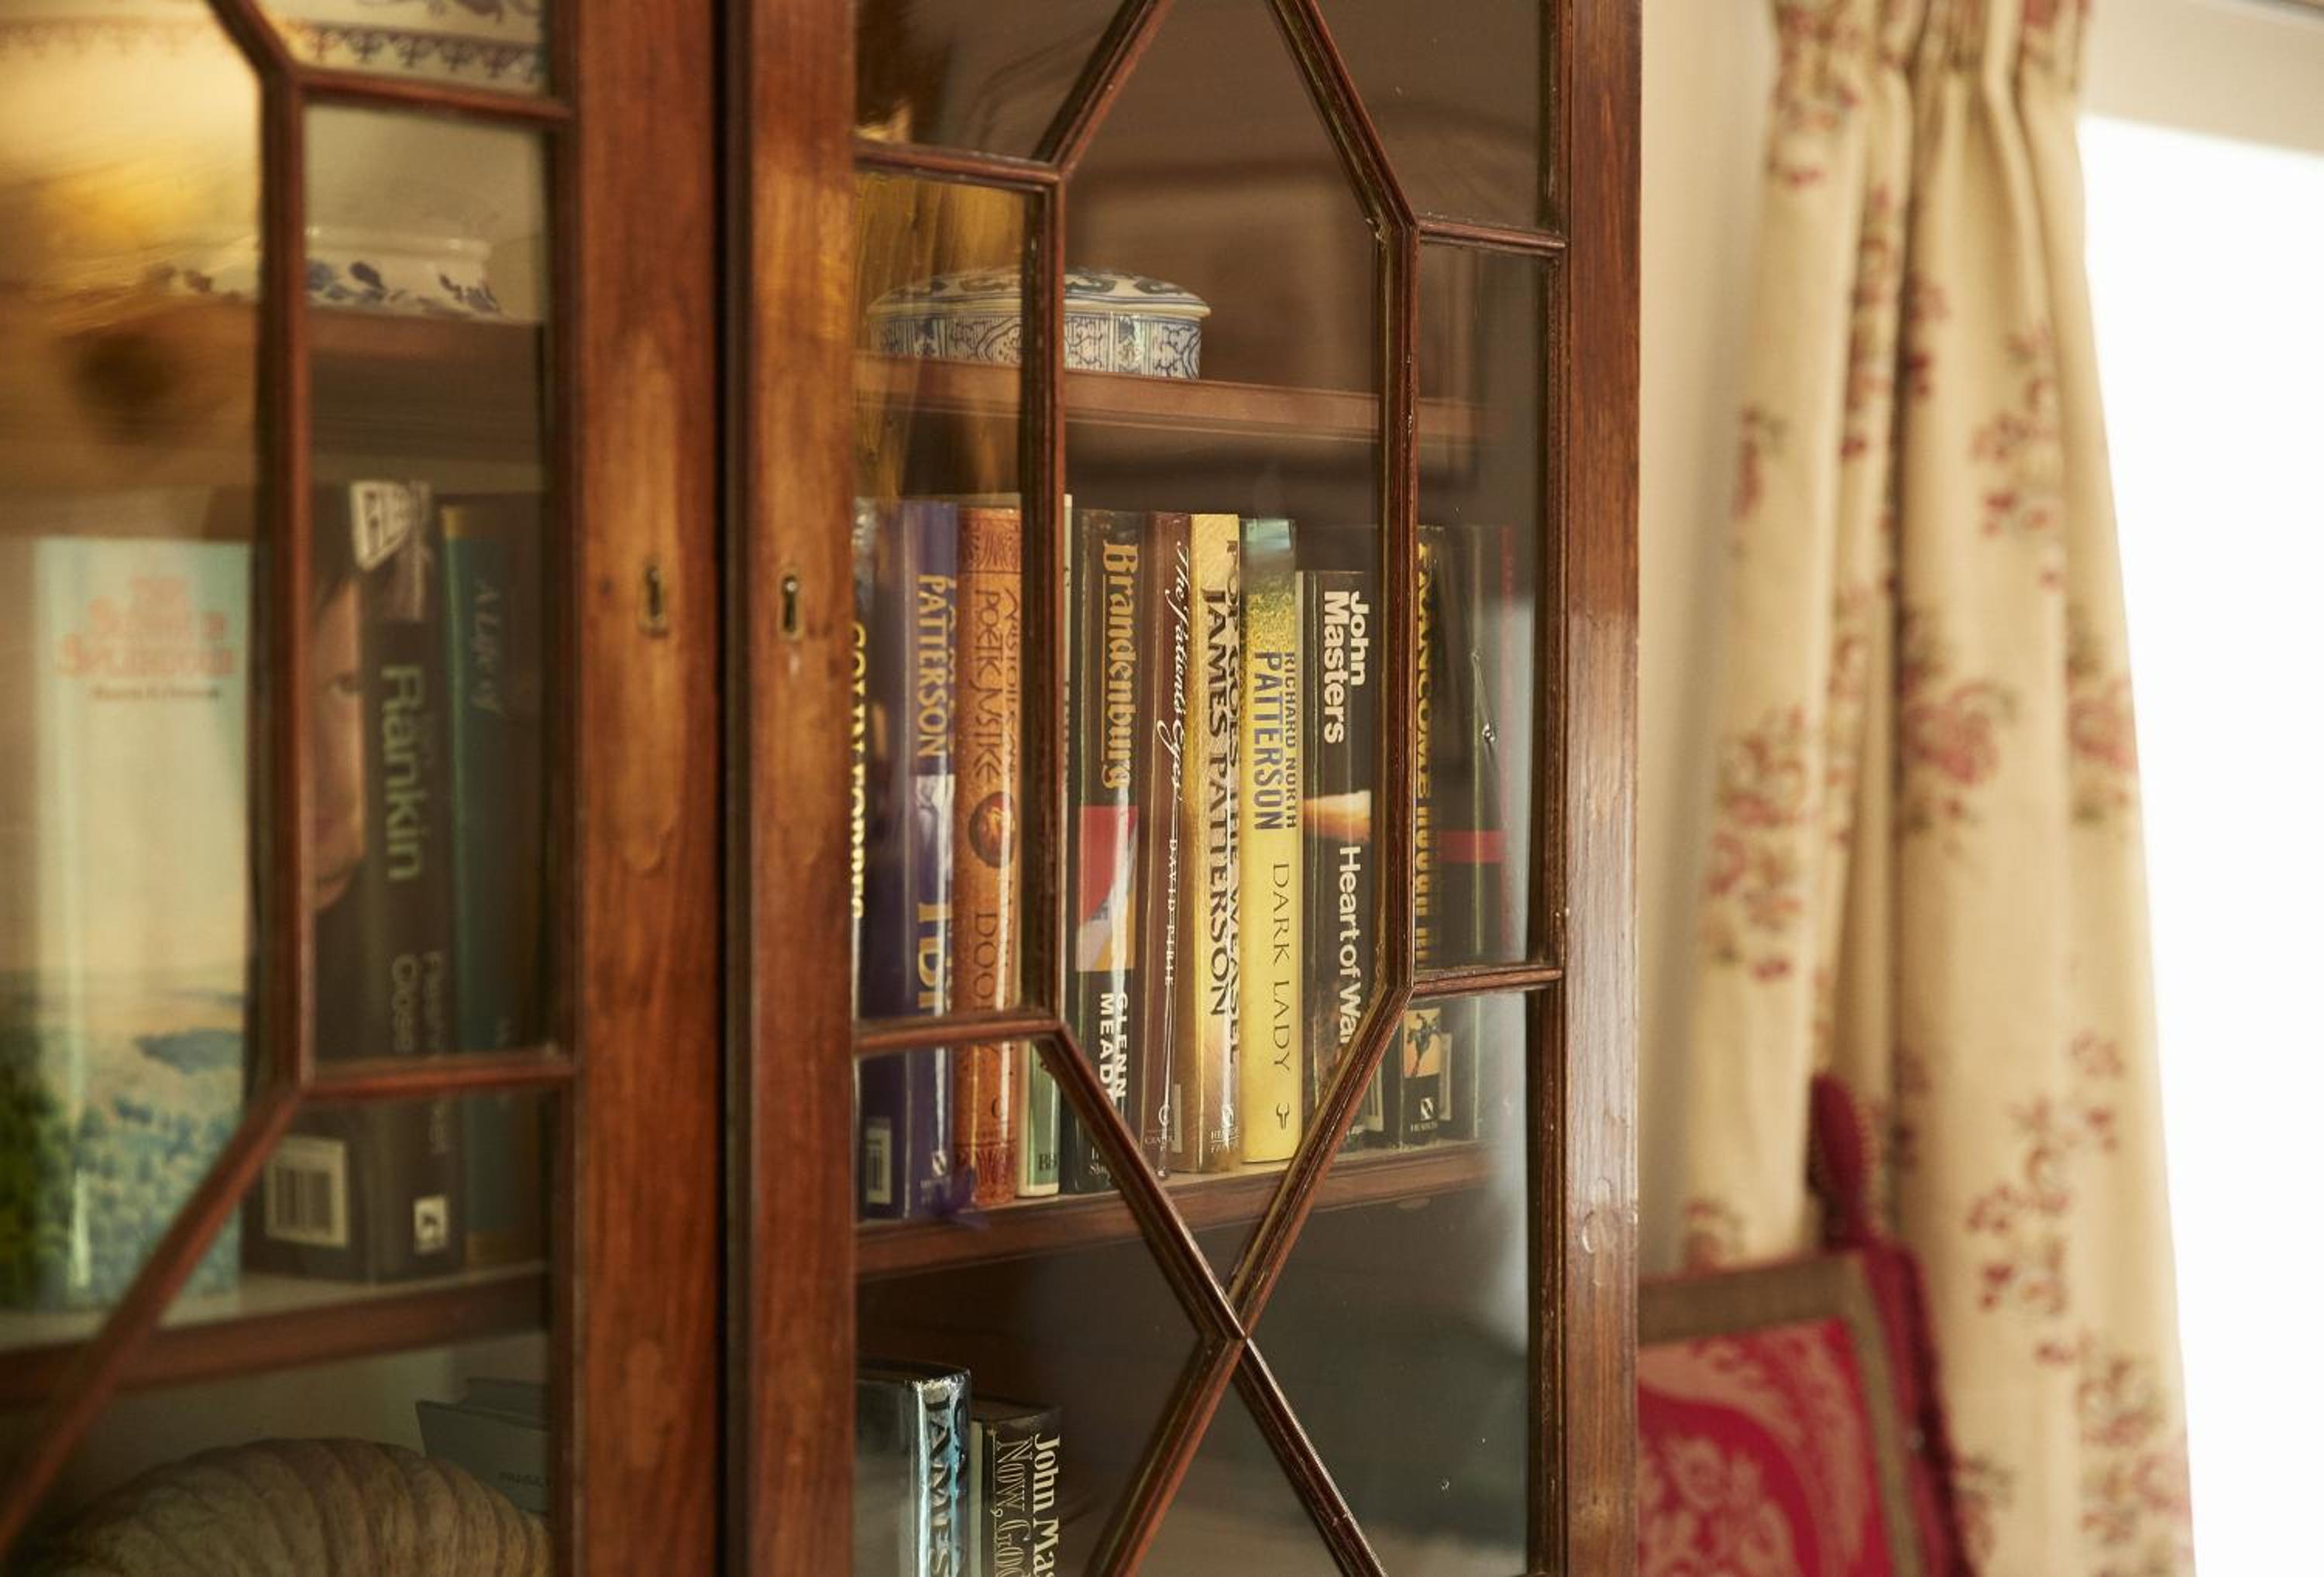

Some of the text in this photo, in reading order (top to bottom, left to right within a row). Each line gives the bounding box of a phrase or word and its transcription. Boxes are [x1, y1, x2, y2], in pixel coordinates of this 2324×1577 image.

[1176, 541, 1191, 600] The
[1349, 591, 1370, 686] John
[917, 575, 947, 757] PATTERSON
[1102, 540, 1139, 788] Brandenburg
[1229, 646, 1239, 768] GOES
[1254, 651, 1284, 830] PATTERSON
[1284, 651, 1297, 830] RICHARD NORTH
[1323, 591, 1350, 744] Masters
[383, 665, 426, 881] Rankin
[1202, 587, 1229, 1015] JAMES PATTERSON
[1229, 881, 1239, 1063] WEASEL
[1272, 861, 1290, 1074] DARK LADY
[1339, 847, 1361, 940] Heart
[1339, 943, 1361, 978] of
[1116, 992, 1129, 1097] GLENN
[924, 1395, 952, 1577] JAMES
[1033, 1433, 1061, 1577] John Ma
